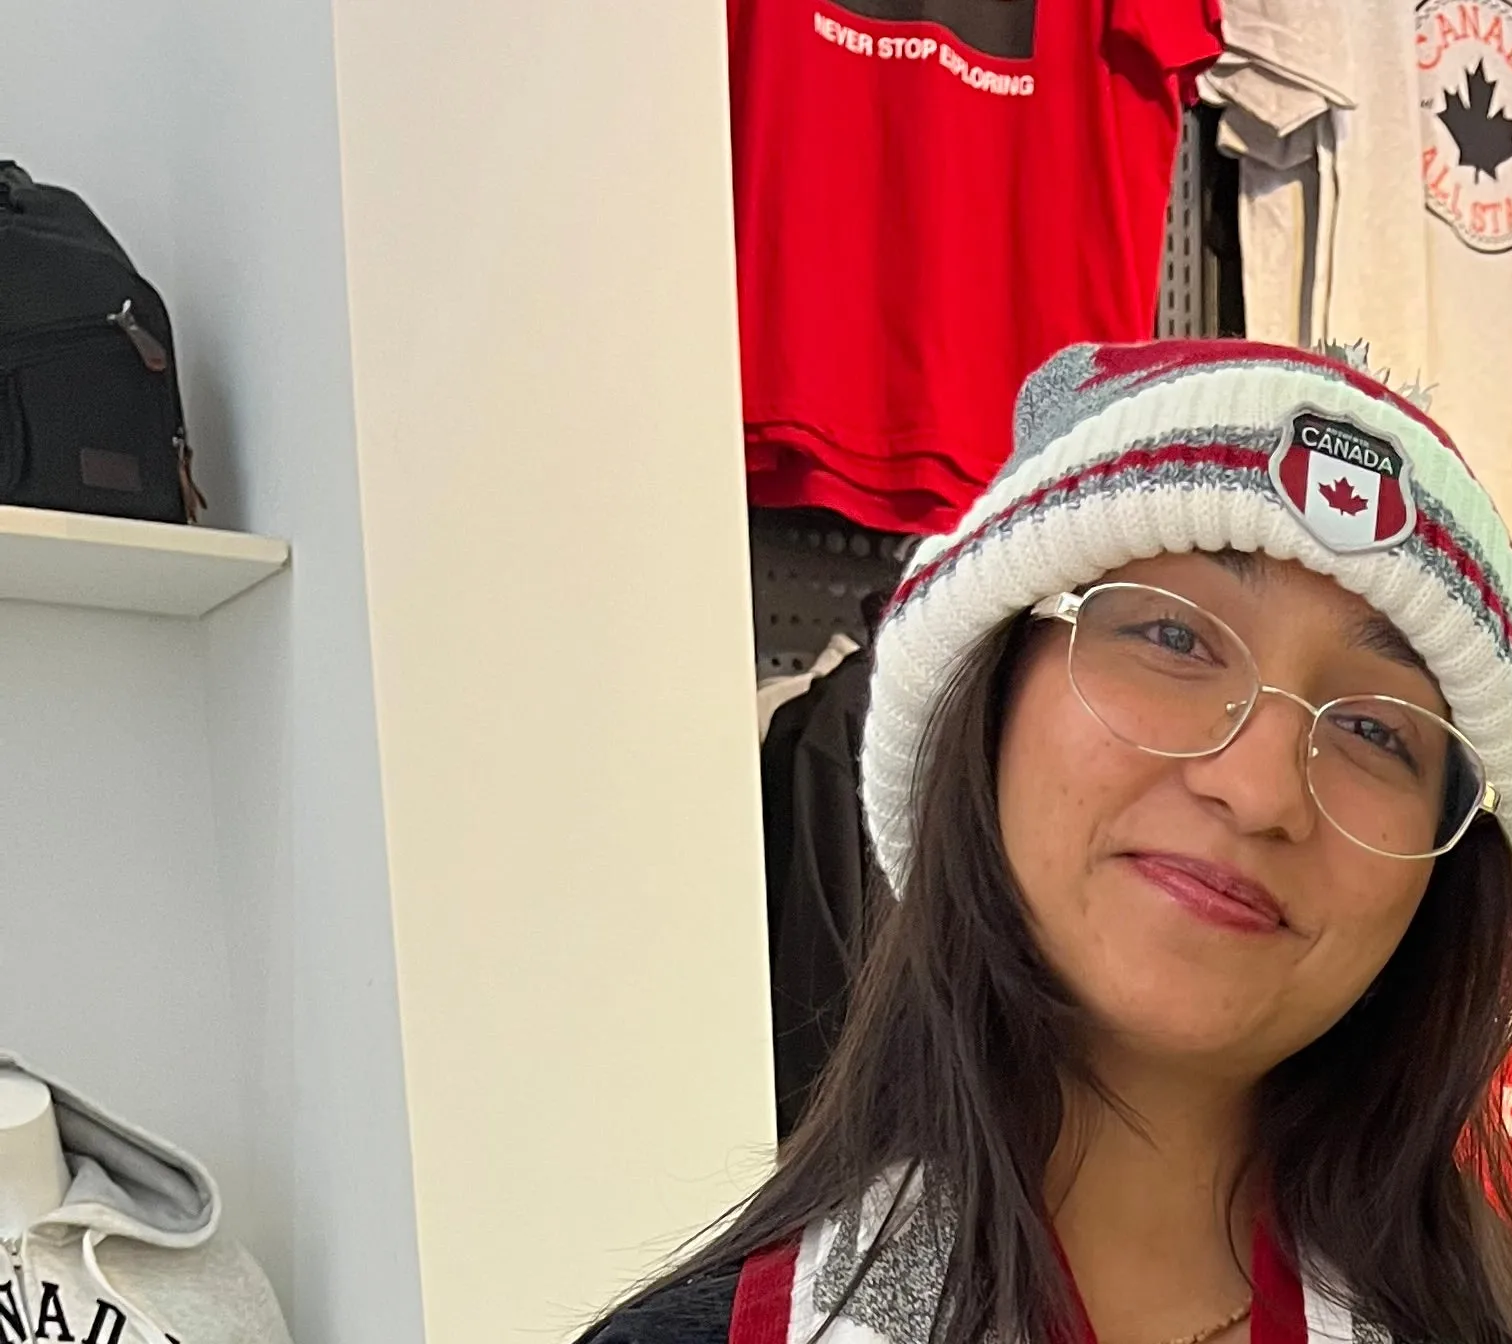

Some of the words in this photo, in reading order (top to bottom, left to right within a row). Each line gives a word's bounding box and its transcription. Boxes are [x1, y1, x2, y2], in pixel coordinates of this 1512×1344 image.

[813, 12, 873, 56] NEVER
[877, 37, 937, 59] STOP
[1301, 427, 1394, 475] CANADA
